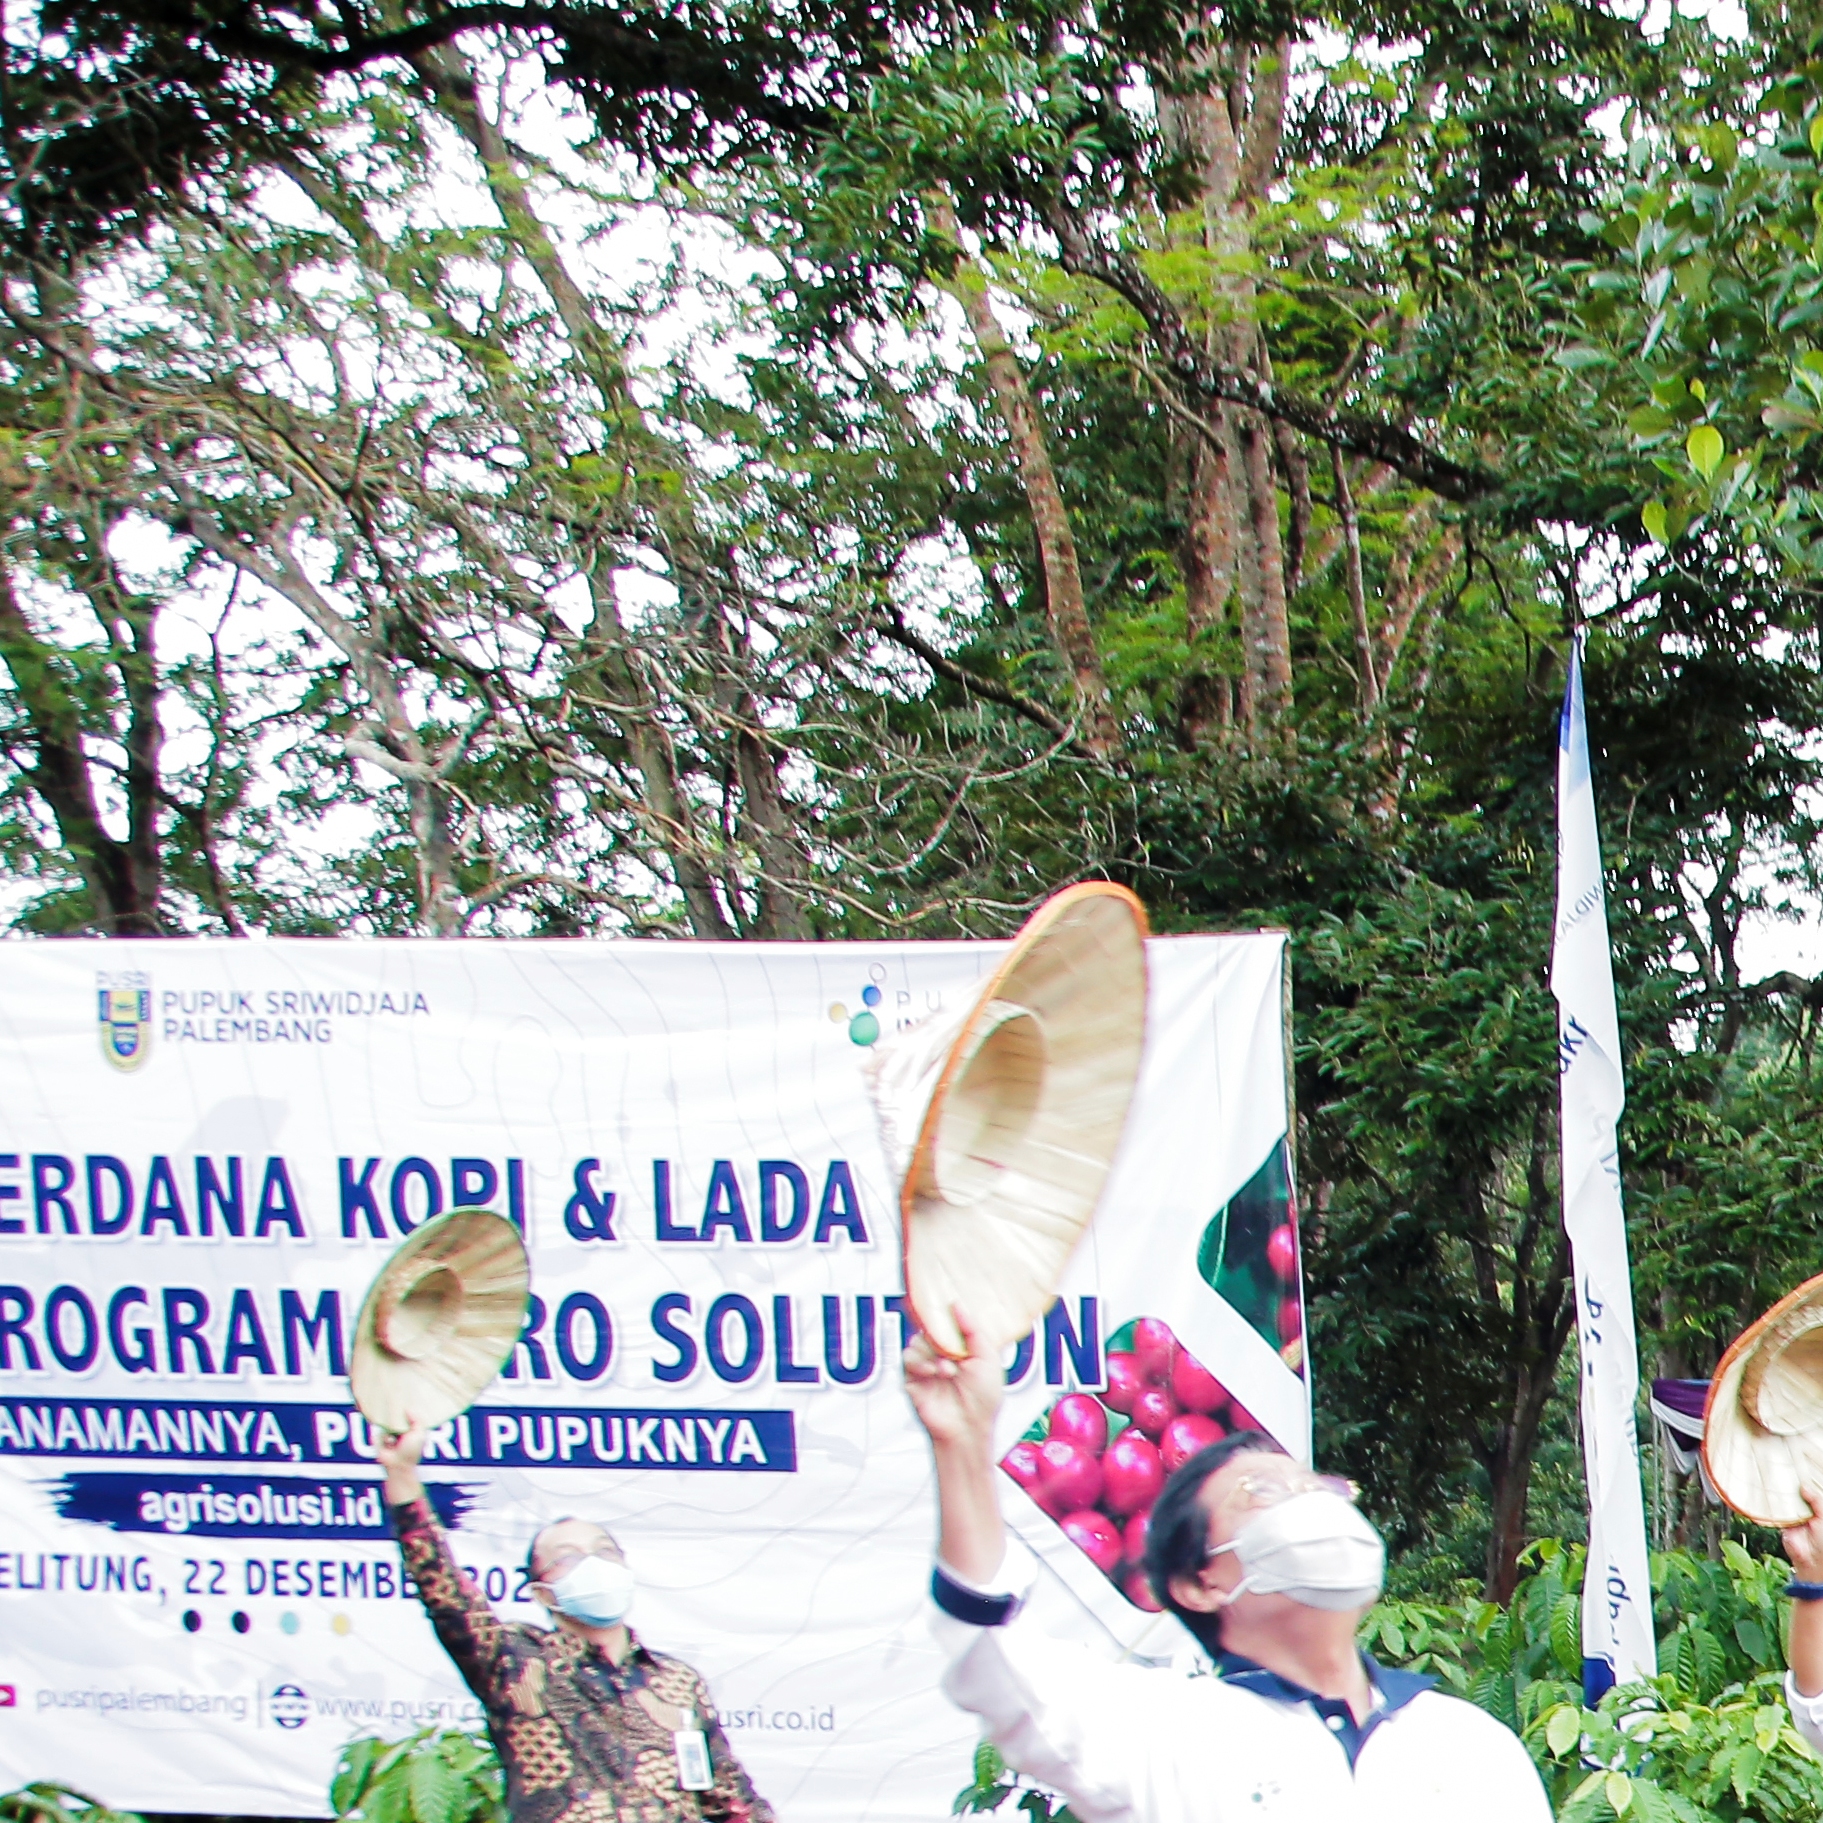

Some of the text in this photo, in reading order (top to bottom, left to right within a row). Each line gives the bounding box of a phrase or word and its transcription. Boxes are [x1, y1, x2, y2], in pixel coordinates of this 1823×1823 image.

[161, 990, 431, 1016] PUPUK SRIWIDJAJA
[162, 1019, 332, 1043] PALEMBANG
[338, 1156, 528, 1238] KOPI
[563, 1157, 617, 1242] &
[653, 1159, 869, 1243] LADA
[504, 1290, 613, 1383] RO
[314, 1410, 473, 1460] PURI
[487, 1414, 769, 1465] PUPUKNYA
[139, 1483, 384, 1532] agrisolusi.id
[184, 1558, 227, 1596] 22
[246, 1558, 420, 1599] DESEMBE
[36, 1686, 248, 1720] pusripalembang
[316, 1694, 485, 1722] www.pusri.c
